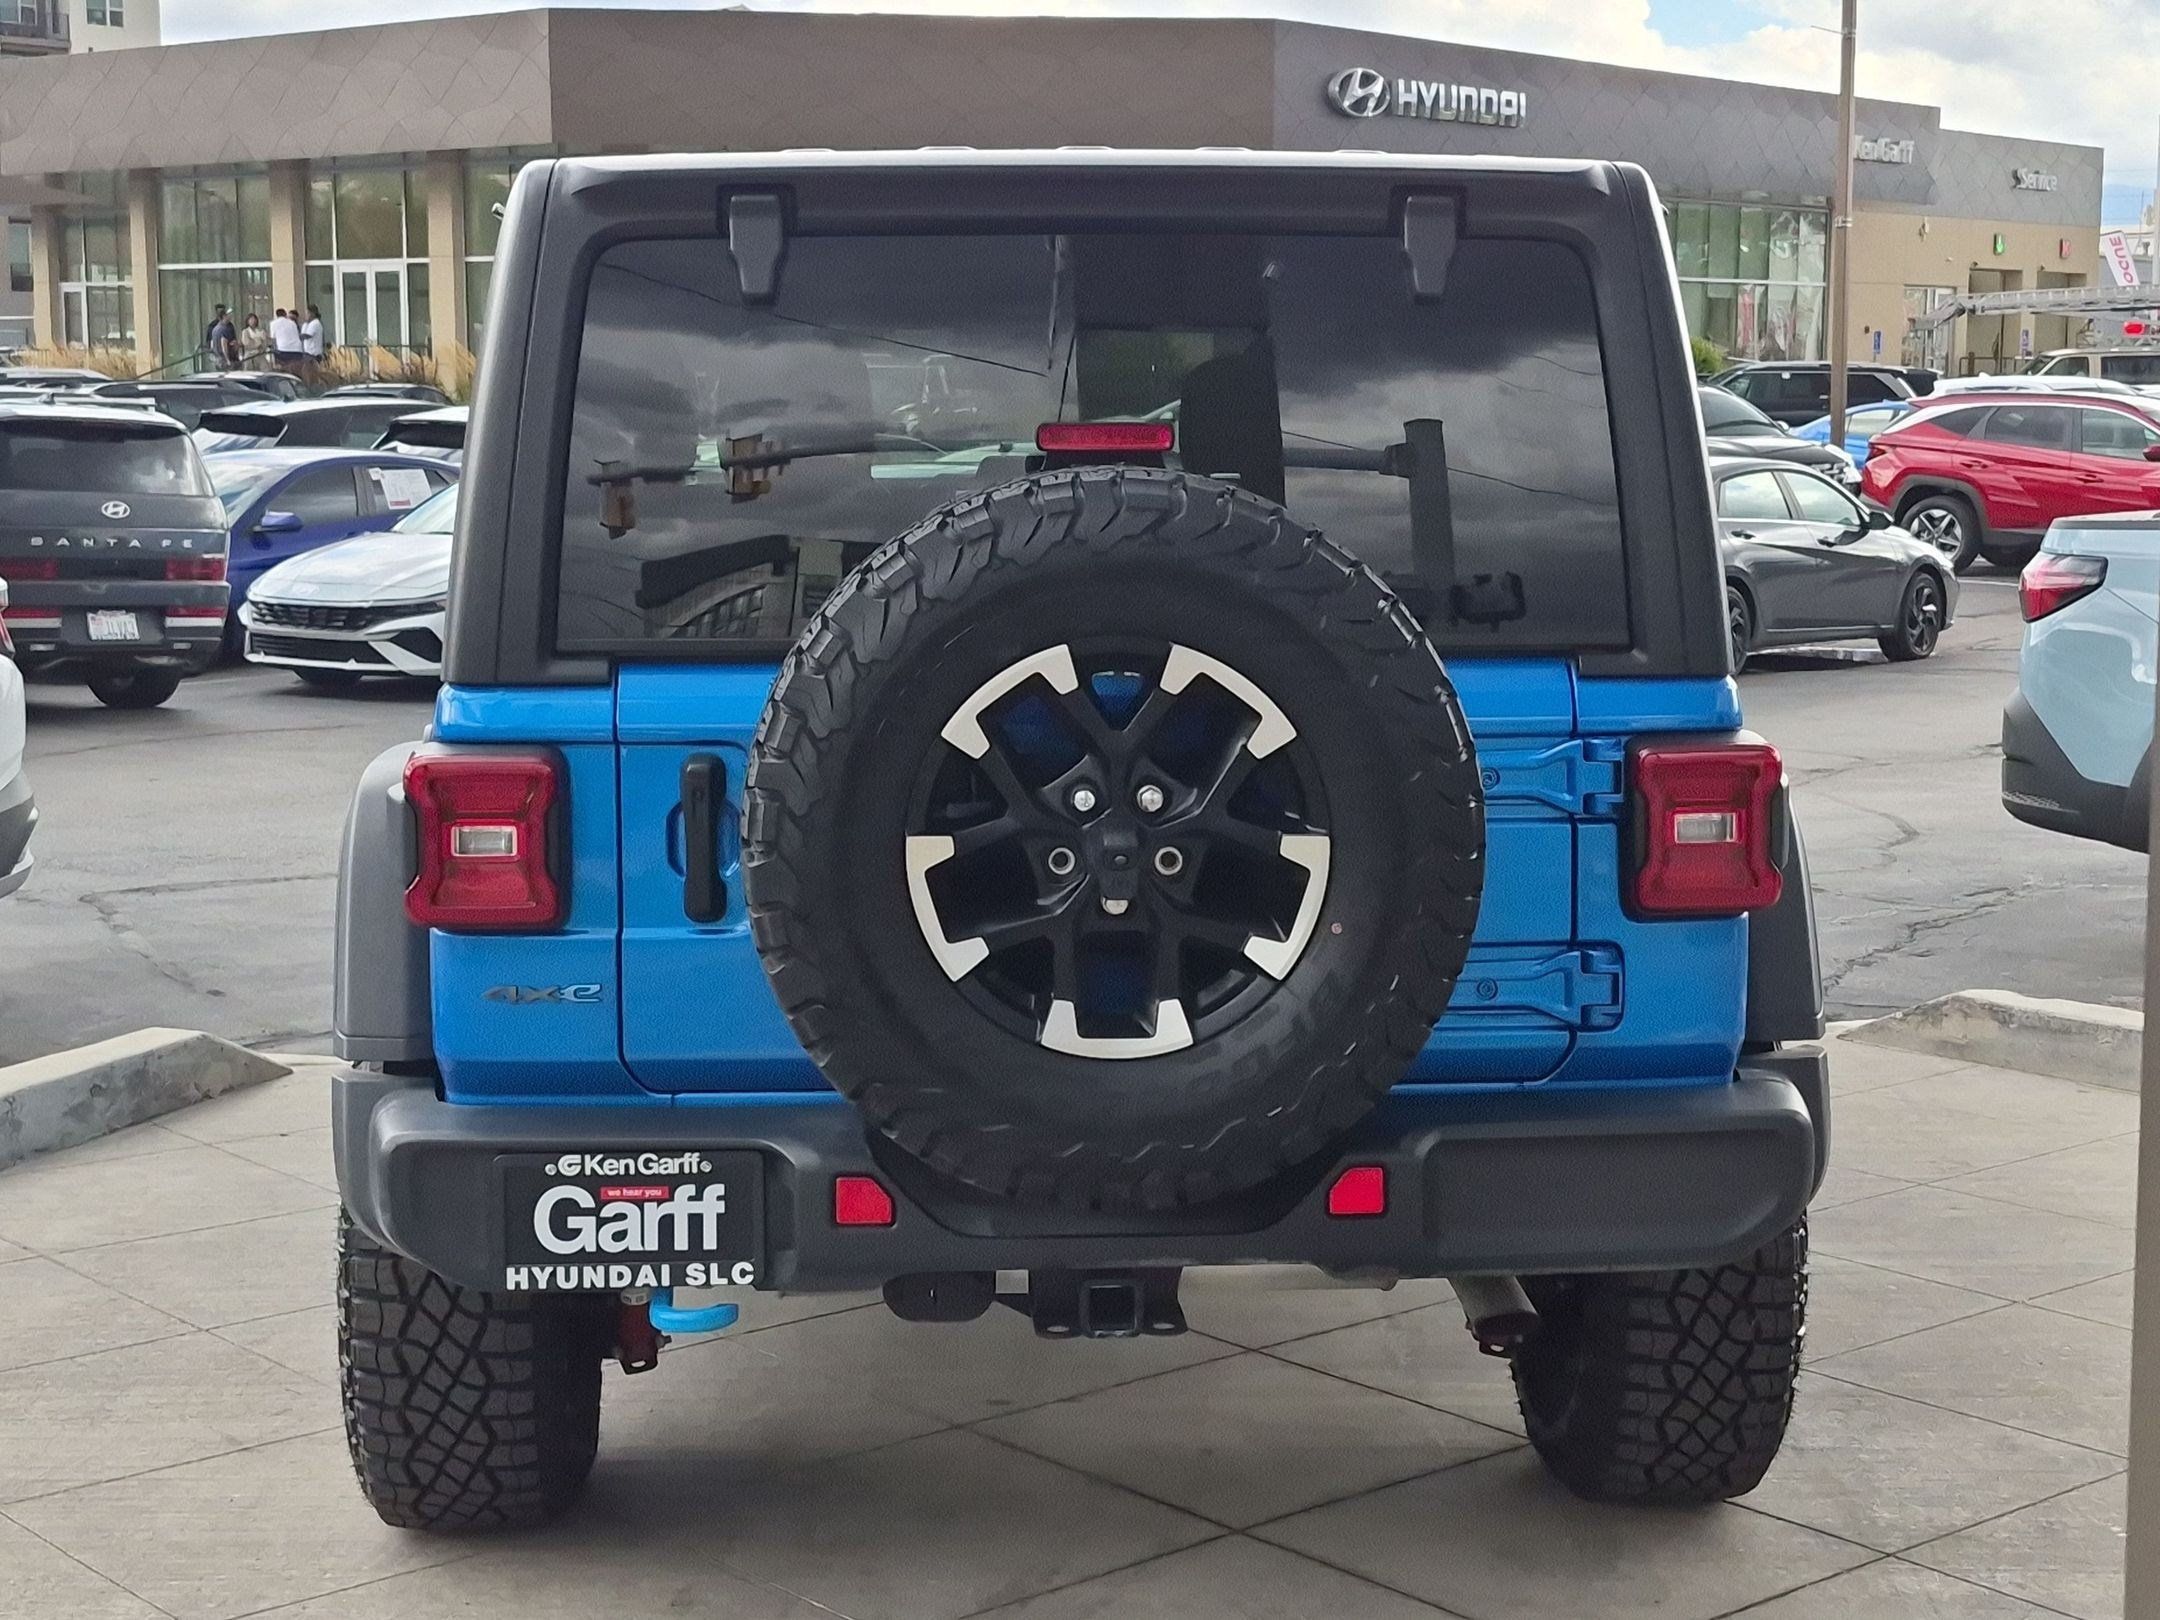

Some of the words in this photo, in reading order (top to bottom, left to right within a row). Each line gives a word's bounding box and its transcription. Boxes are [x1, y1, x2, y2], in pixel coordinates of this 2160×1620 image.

[1397, 78, 1527, 128] HYUNDAI
[30, 536, 142, 548] SANTA
[161, 538, 193, 548] FE
[623, 1187, 643, 1197] hear
[644, 1189, 662, 1198] you
[533, 1183, 726, 1255] Garff
[506, 1263, 671, 1291] HYUNDAI
[685, 1260, 755, 1287] SLC
